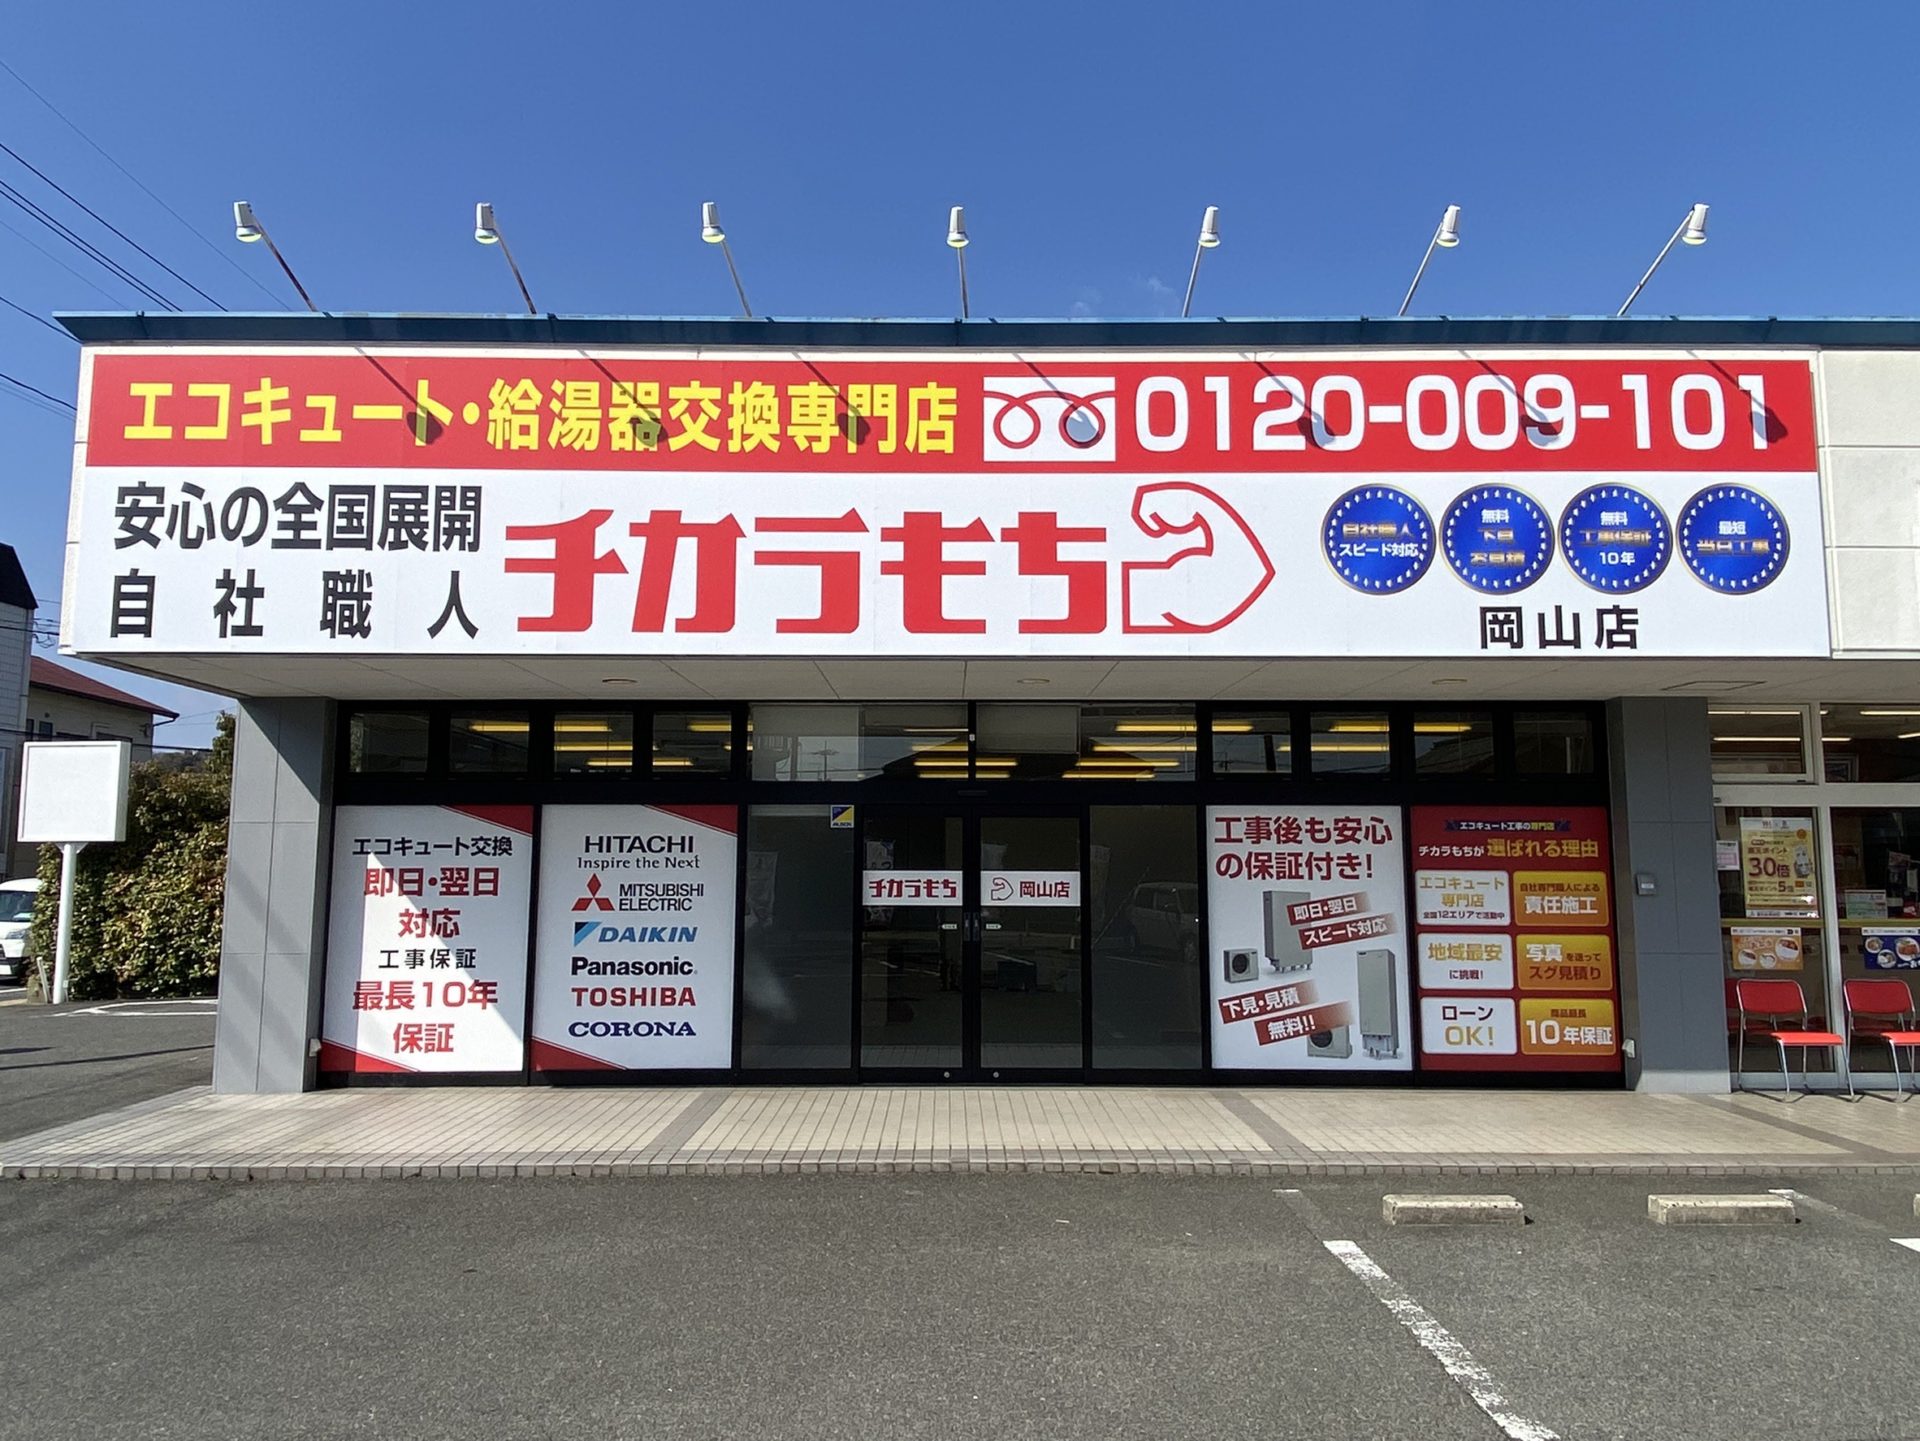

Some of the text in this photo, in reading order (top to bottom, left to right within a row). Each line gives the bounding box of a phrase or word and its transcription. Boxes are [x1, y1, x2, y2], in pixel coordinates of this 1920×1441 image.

[124, 376, 957, 455] エコキュート・給湯器交換専門店
[1135, 374, 1770, 452] 0120-009-101
[113, 481, 482, 552] 安心の全国展開
[1481, 509, 1510, 523] 無料
[1600, 511, 1628, 526] 無料
[1719, 521, 1747, 535] 最短
[1339, 543, 1419, 558] スピード対応
[1600, 552, 1635, 566] 10年
[504, 508, 1107, 634] チカラもち
[1479, 606, 1640, 650] 岡山店
[1214, 816, 1393, 845] 工事後も安心
[352, 836, 513, 857] エコキュート交換
[585, 835, 694, 854] HITACHI
[577, 852, 700, 872] Inspire the Next
[1215, 851, 1374, 880] の保証付き!
[363, 867, 500, 897] 即日・翌日
[619, 883, 704, 897] MITSUBISHI
[869, 879, 957, 898] チカラもち
[1019, 881, 1070, 898] 岡山店
[1419, 877, 1504, 890] エコキュート
[619, 898, 693, 912] ELECTRIC
[1293, 896, 1358, 921] 即日・翌日
[1441, 893, 1484, 908] 専門店
[1524, 896, 1598, 915] 責任施工
[398, 908, 461, 938] 対応
[1304, 918, 1388, 946] スピード対応
[599, 926, 698, 943] DAIKIN
[378, 948, 477, 970] 工事保証
[1427, 943, 1502, 962] 地域最安
[571, 956, 693, 976] Panasonic
[1529, 966, 1601, 980] スグ見積り
[352, 980, 498, 1011] 最長10年
[572, 987, 696, 1007] TOSHIBA
[1442, 1006, 1493, 1021] ローン
[392, 1023, 455, 1054] 保証
[568, 1021, 697, 1038] CORONA
[1445, 1025, 1495, 1046] OK!
